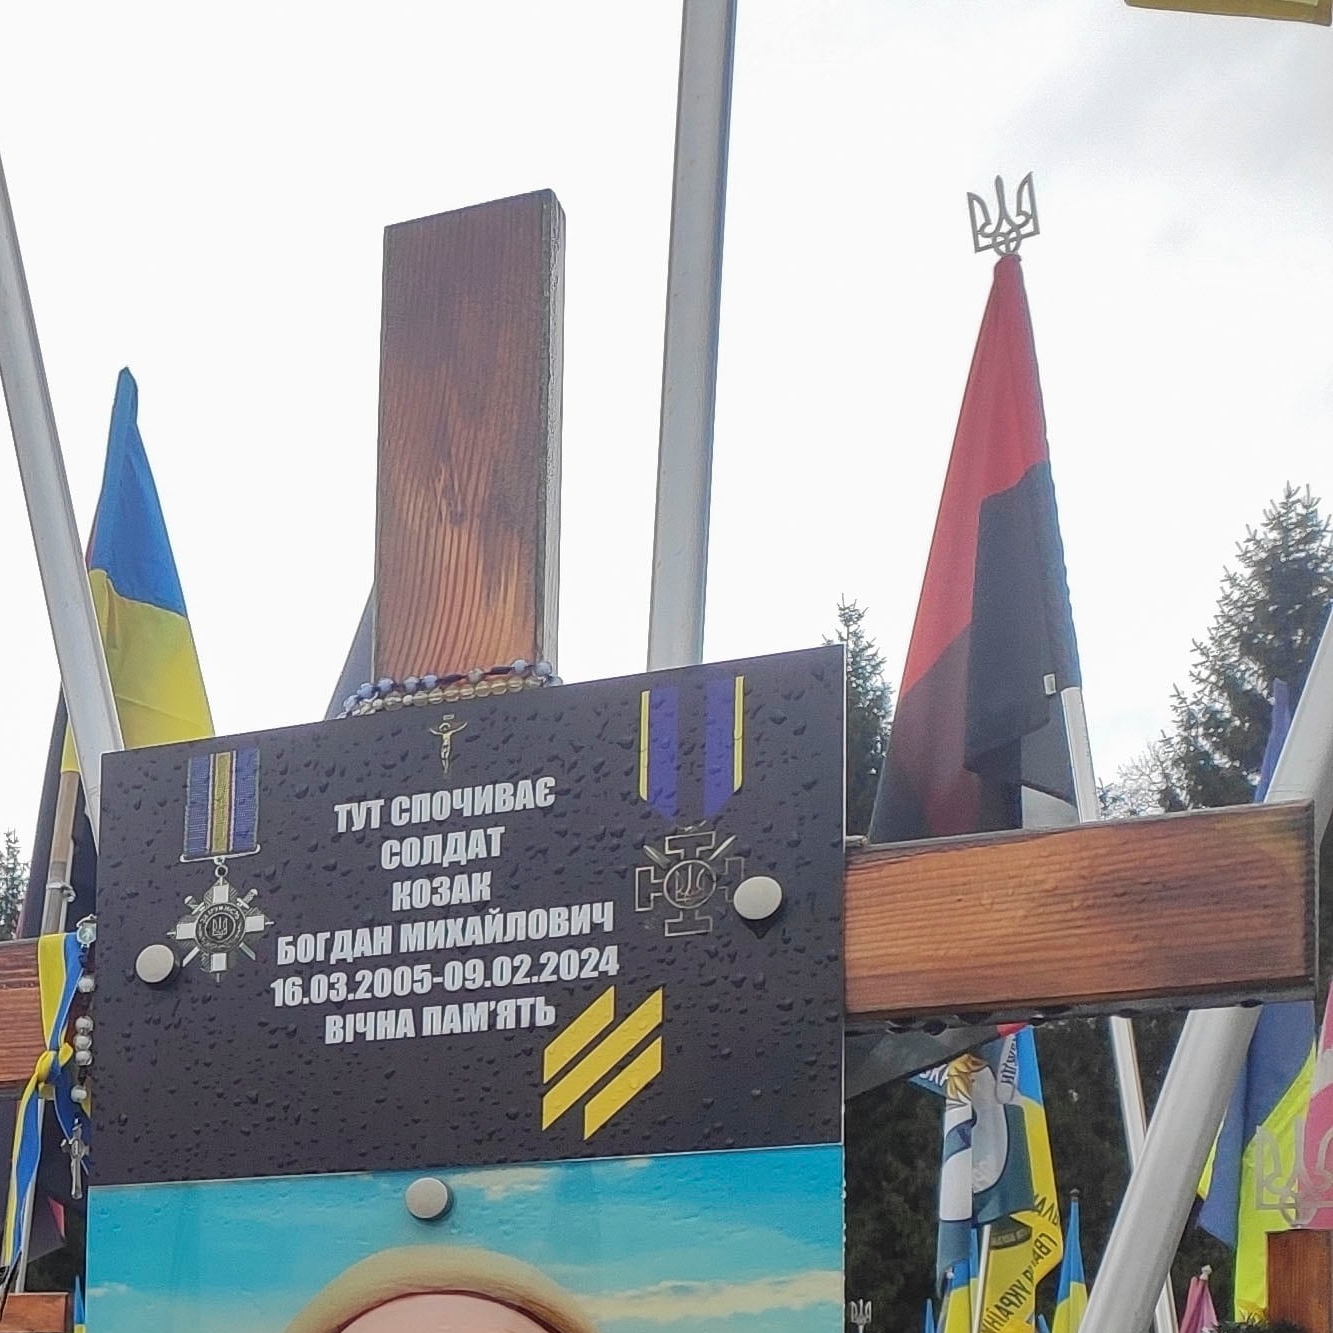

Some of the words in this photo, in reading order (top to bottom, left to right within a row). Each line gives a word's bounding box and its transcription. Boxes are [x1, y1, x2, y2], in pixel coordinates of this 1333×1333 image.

[333, 799, 385, 833] ТУТ
[390, 776, 557, 827] СПОЧИВАЄ
[380, 826, 506, 870] СОЛДАТ
[391, 871, 493, 912] КОЗАК
[276, 925, 393, 966] БОГДАН
[399, 901, 615, 953] МИХАЙЛОВИЧ
[269, 944, 620, 1008] 16.03.2005-09.02.2024
[324, 1008, 416, 1045] ВІЧНА
[421, 995, 557, 1037] ПАМ'ЯТЬ
